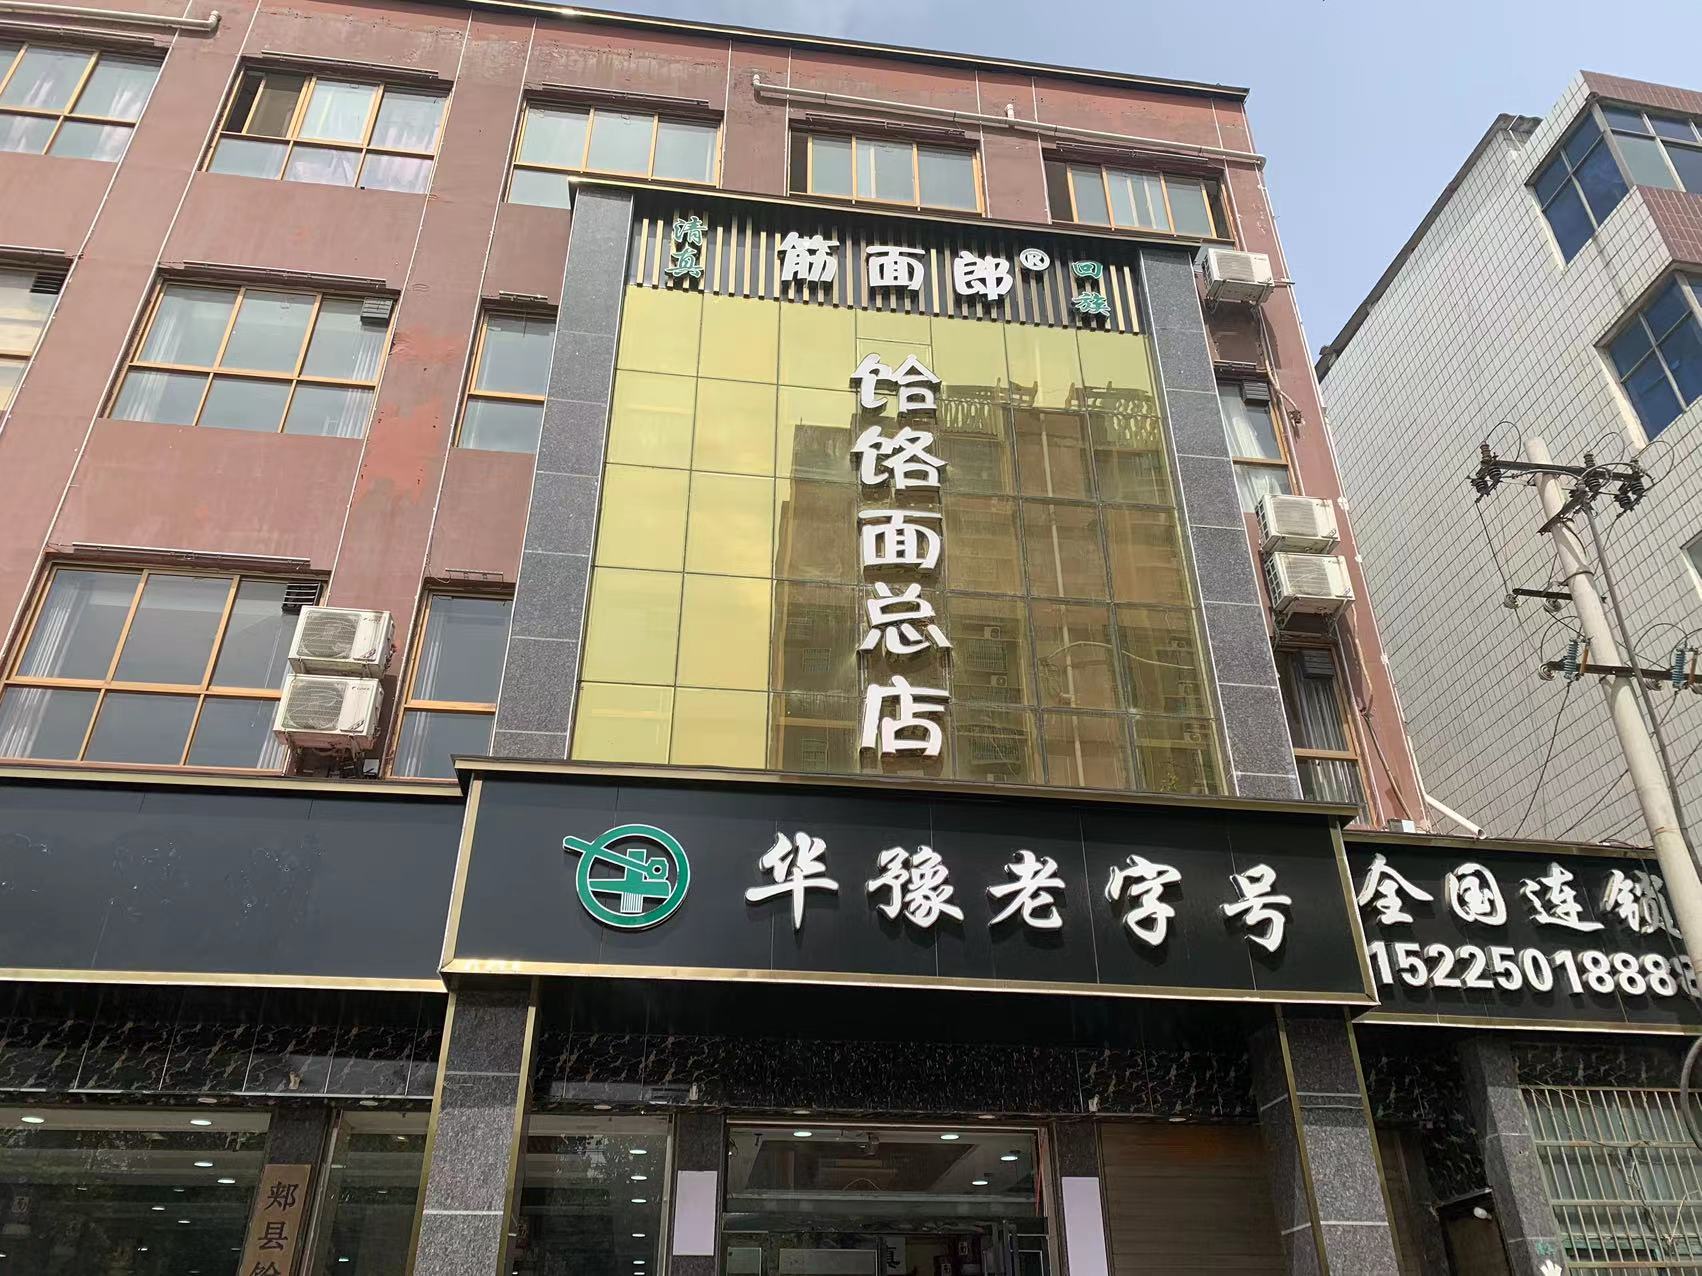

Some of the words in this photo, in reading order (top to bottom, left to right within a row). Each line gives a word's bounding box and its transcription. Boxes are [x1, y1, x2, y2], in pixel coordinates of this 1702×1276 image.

[664, 215, 709, 279] 清真
[1071, 261, 1111, 317] 回族
[850, 353, 953, 757] 饸饹面总店
[745, 831, 1293, 953] 华豫老字号
[1356, 853, 1683, 940] 全国连锁
